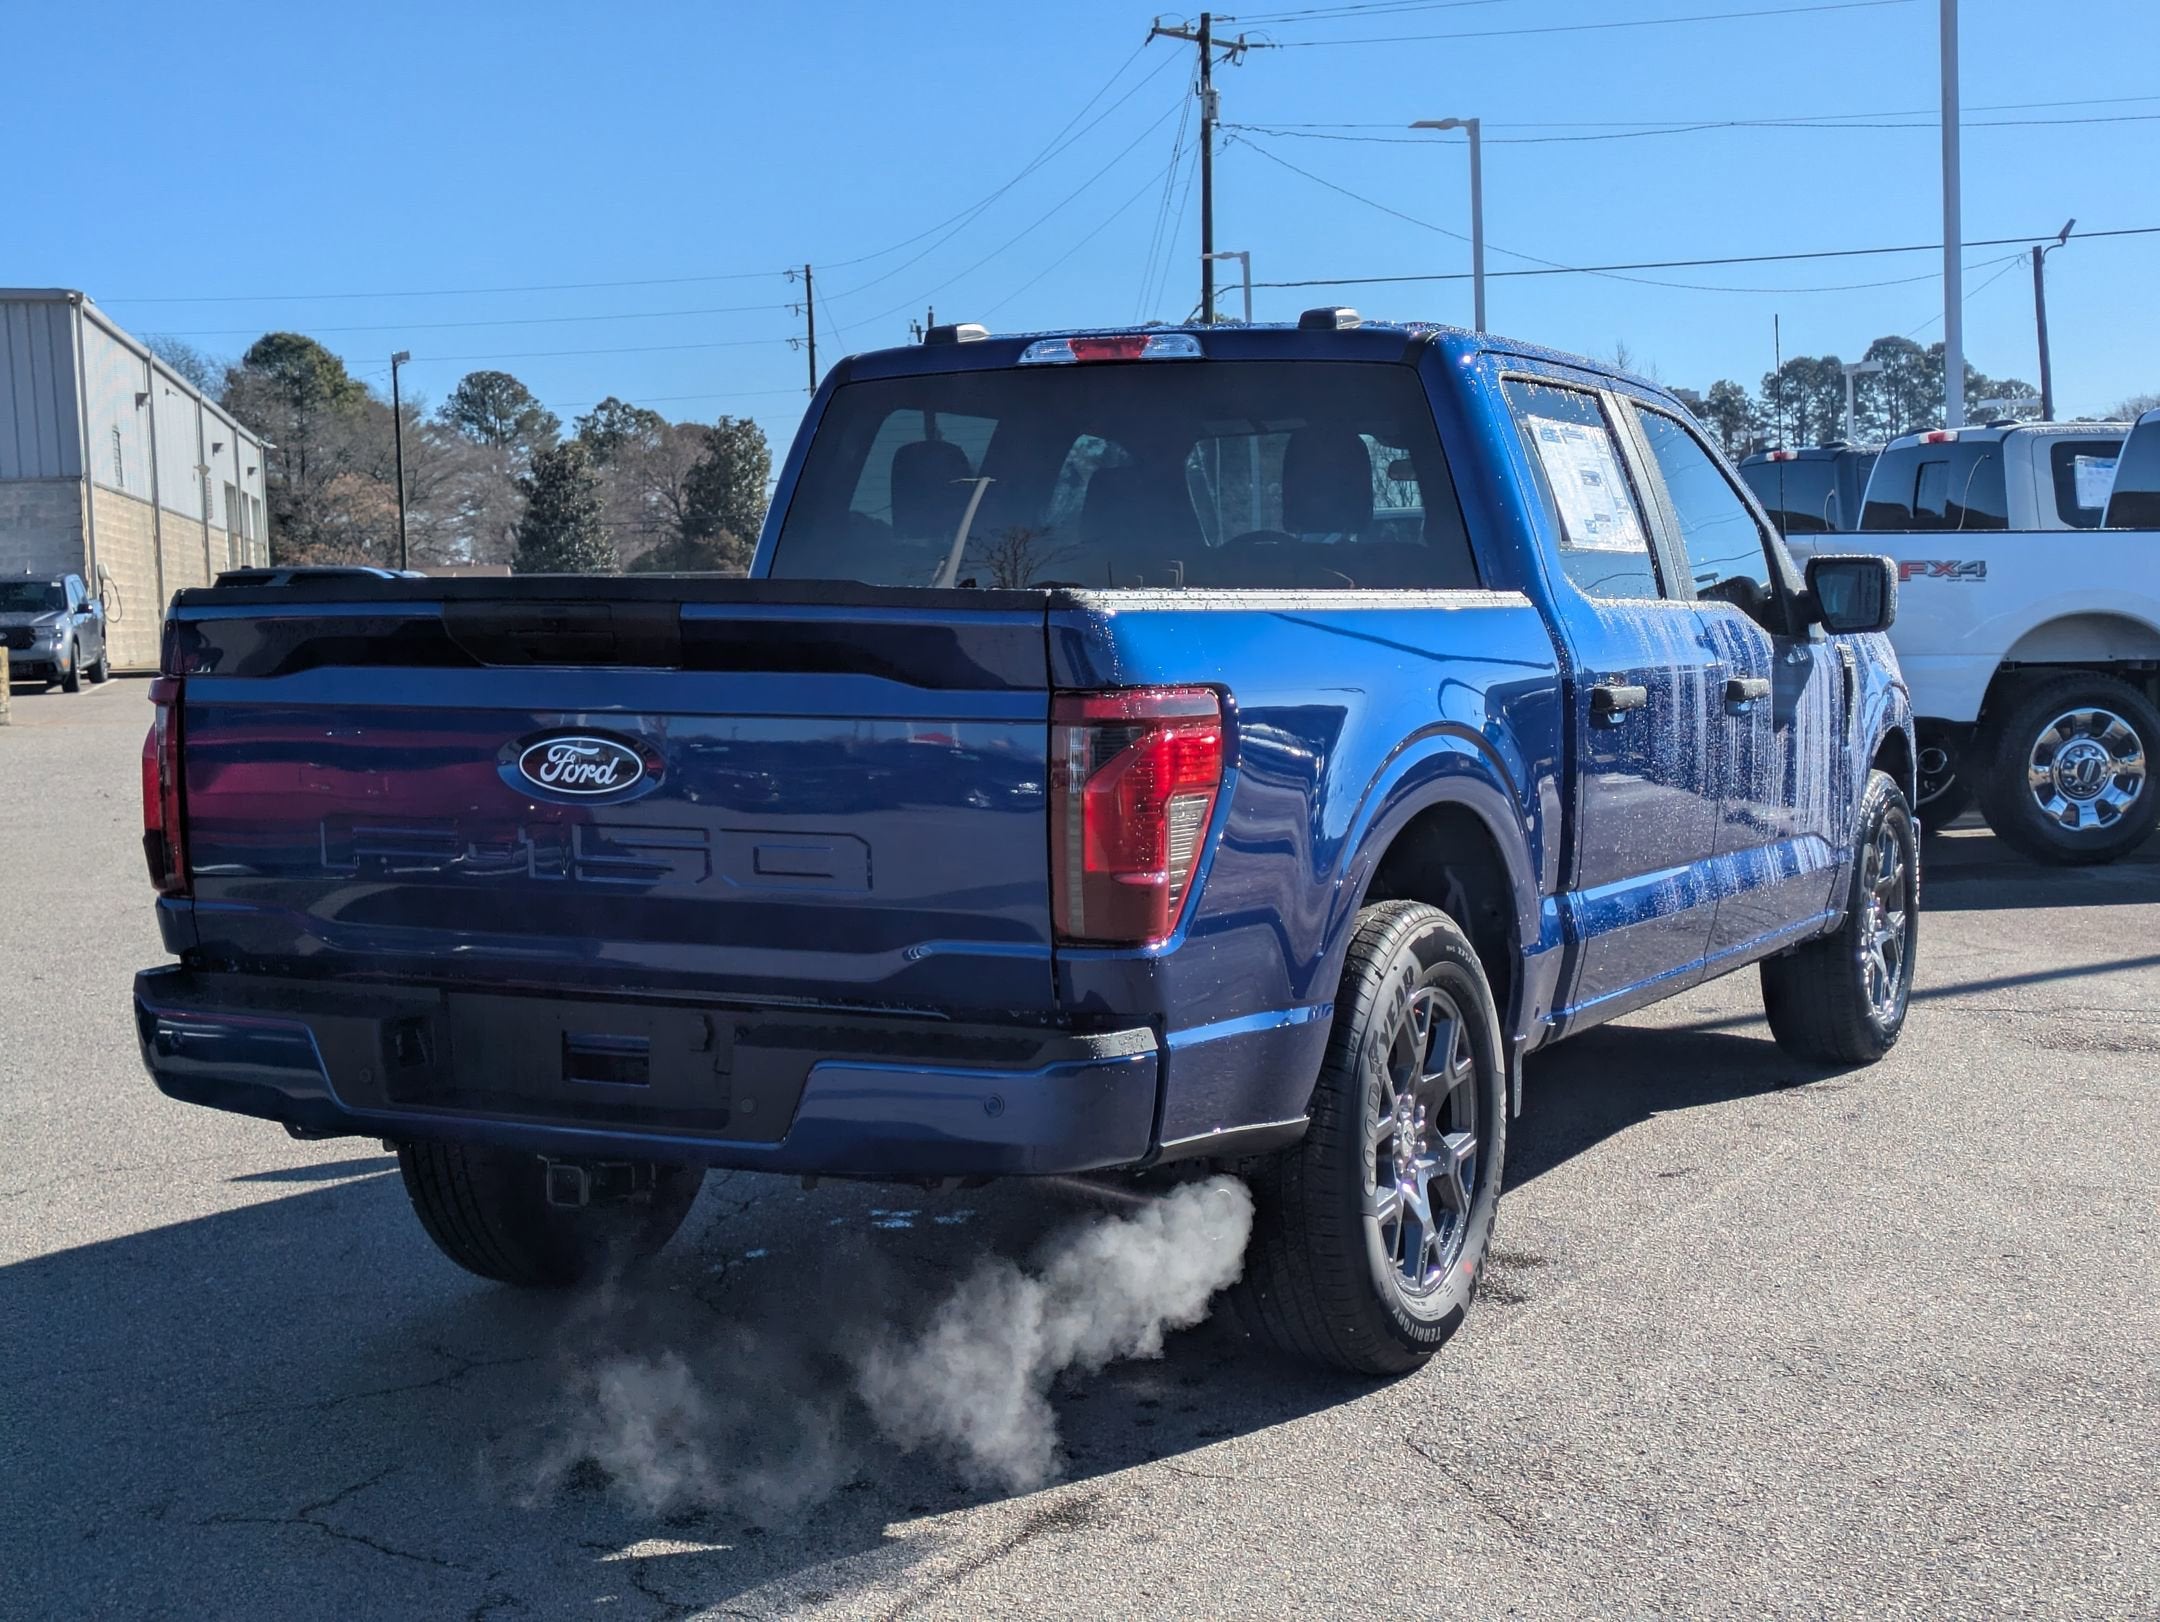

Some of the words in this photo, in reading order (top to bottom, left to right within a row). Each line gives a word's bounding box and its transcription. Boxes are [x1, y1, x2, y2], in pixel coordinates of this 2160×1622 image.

[1898, 559, 1988, 582] FX4
[539, 744, 620, 785] Ford
[1392, 1306, 1441, 1342] TERRITORY
